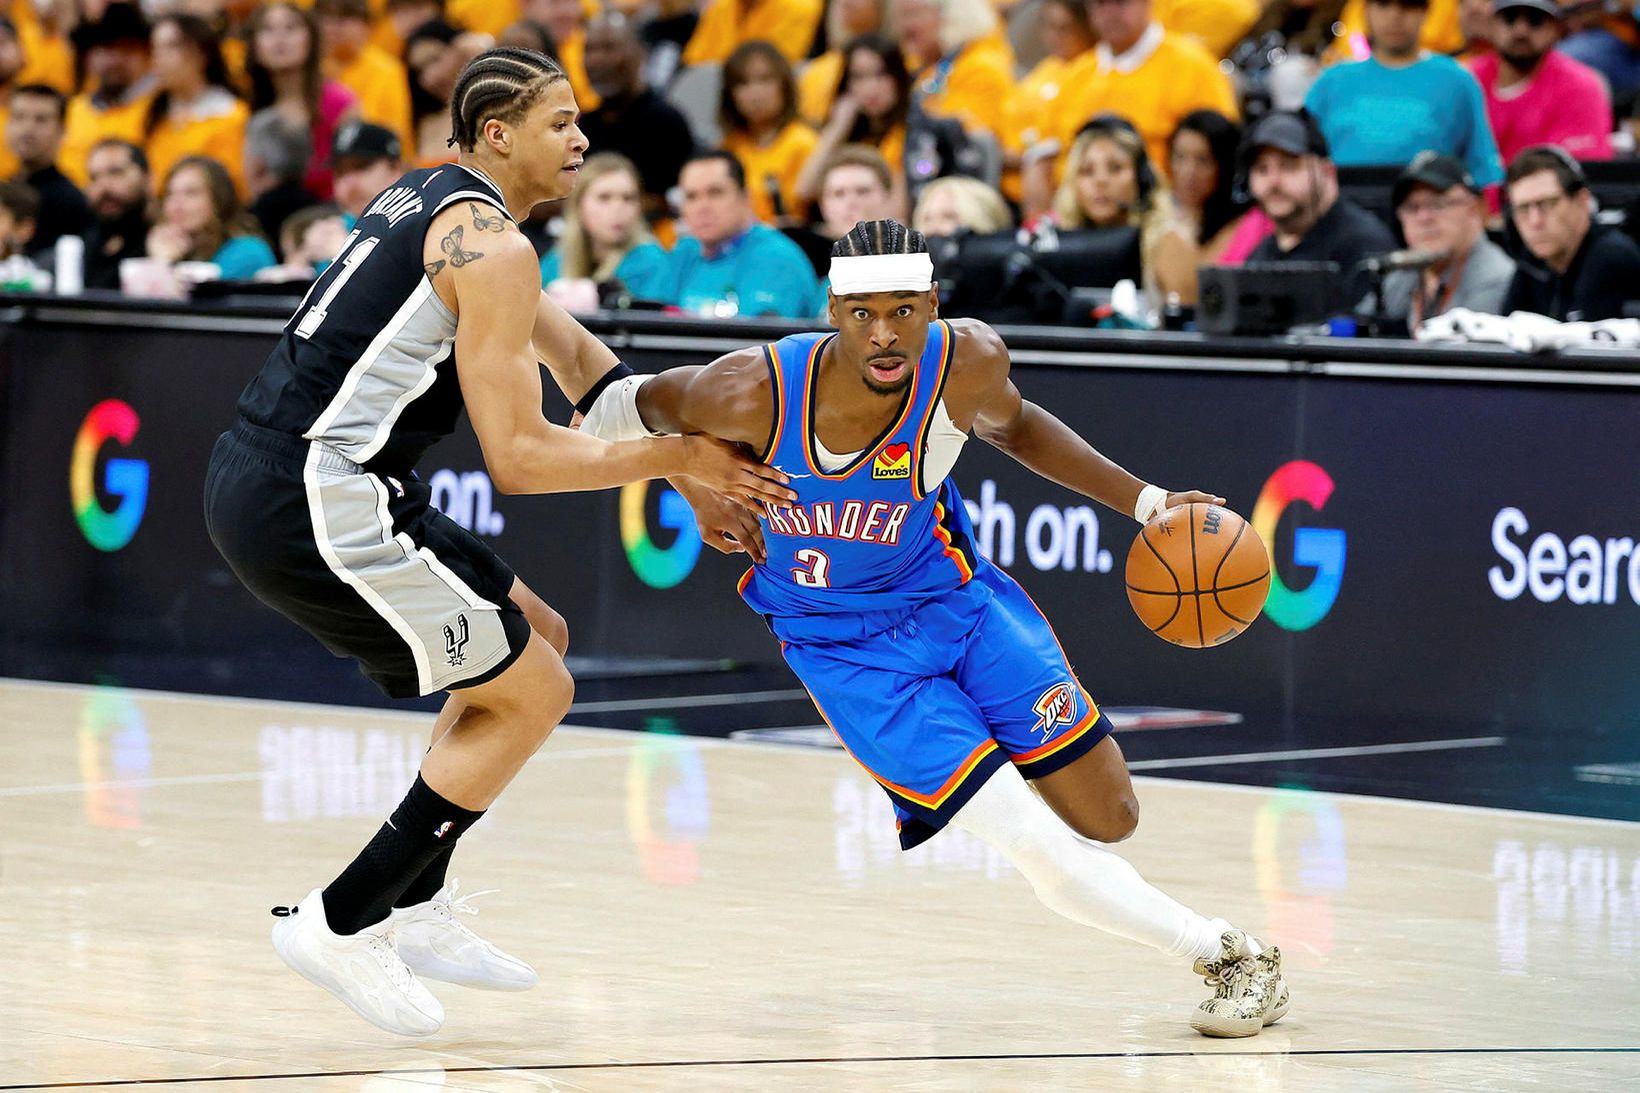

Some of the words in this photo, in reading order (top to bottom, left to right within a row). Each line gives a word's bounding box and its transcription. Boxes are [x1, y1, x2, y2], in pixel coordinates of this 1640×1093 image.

[70, 398, 149, 552] G
[429, 468, 505, 536] on.
[762, 499, 911, 546] HUNDER
[1025, 504, 1113, 574] on.
[1250, 459, 1347, 632] G
[791, 548, 831, 588] 3
